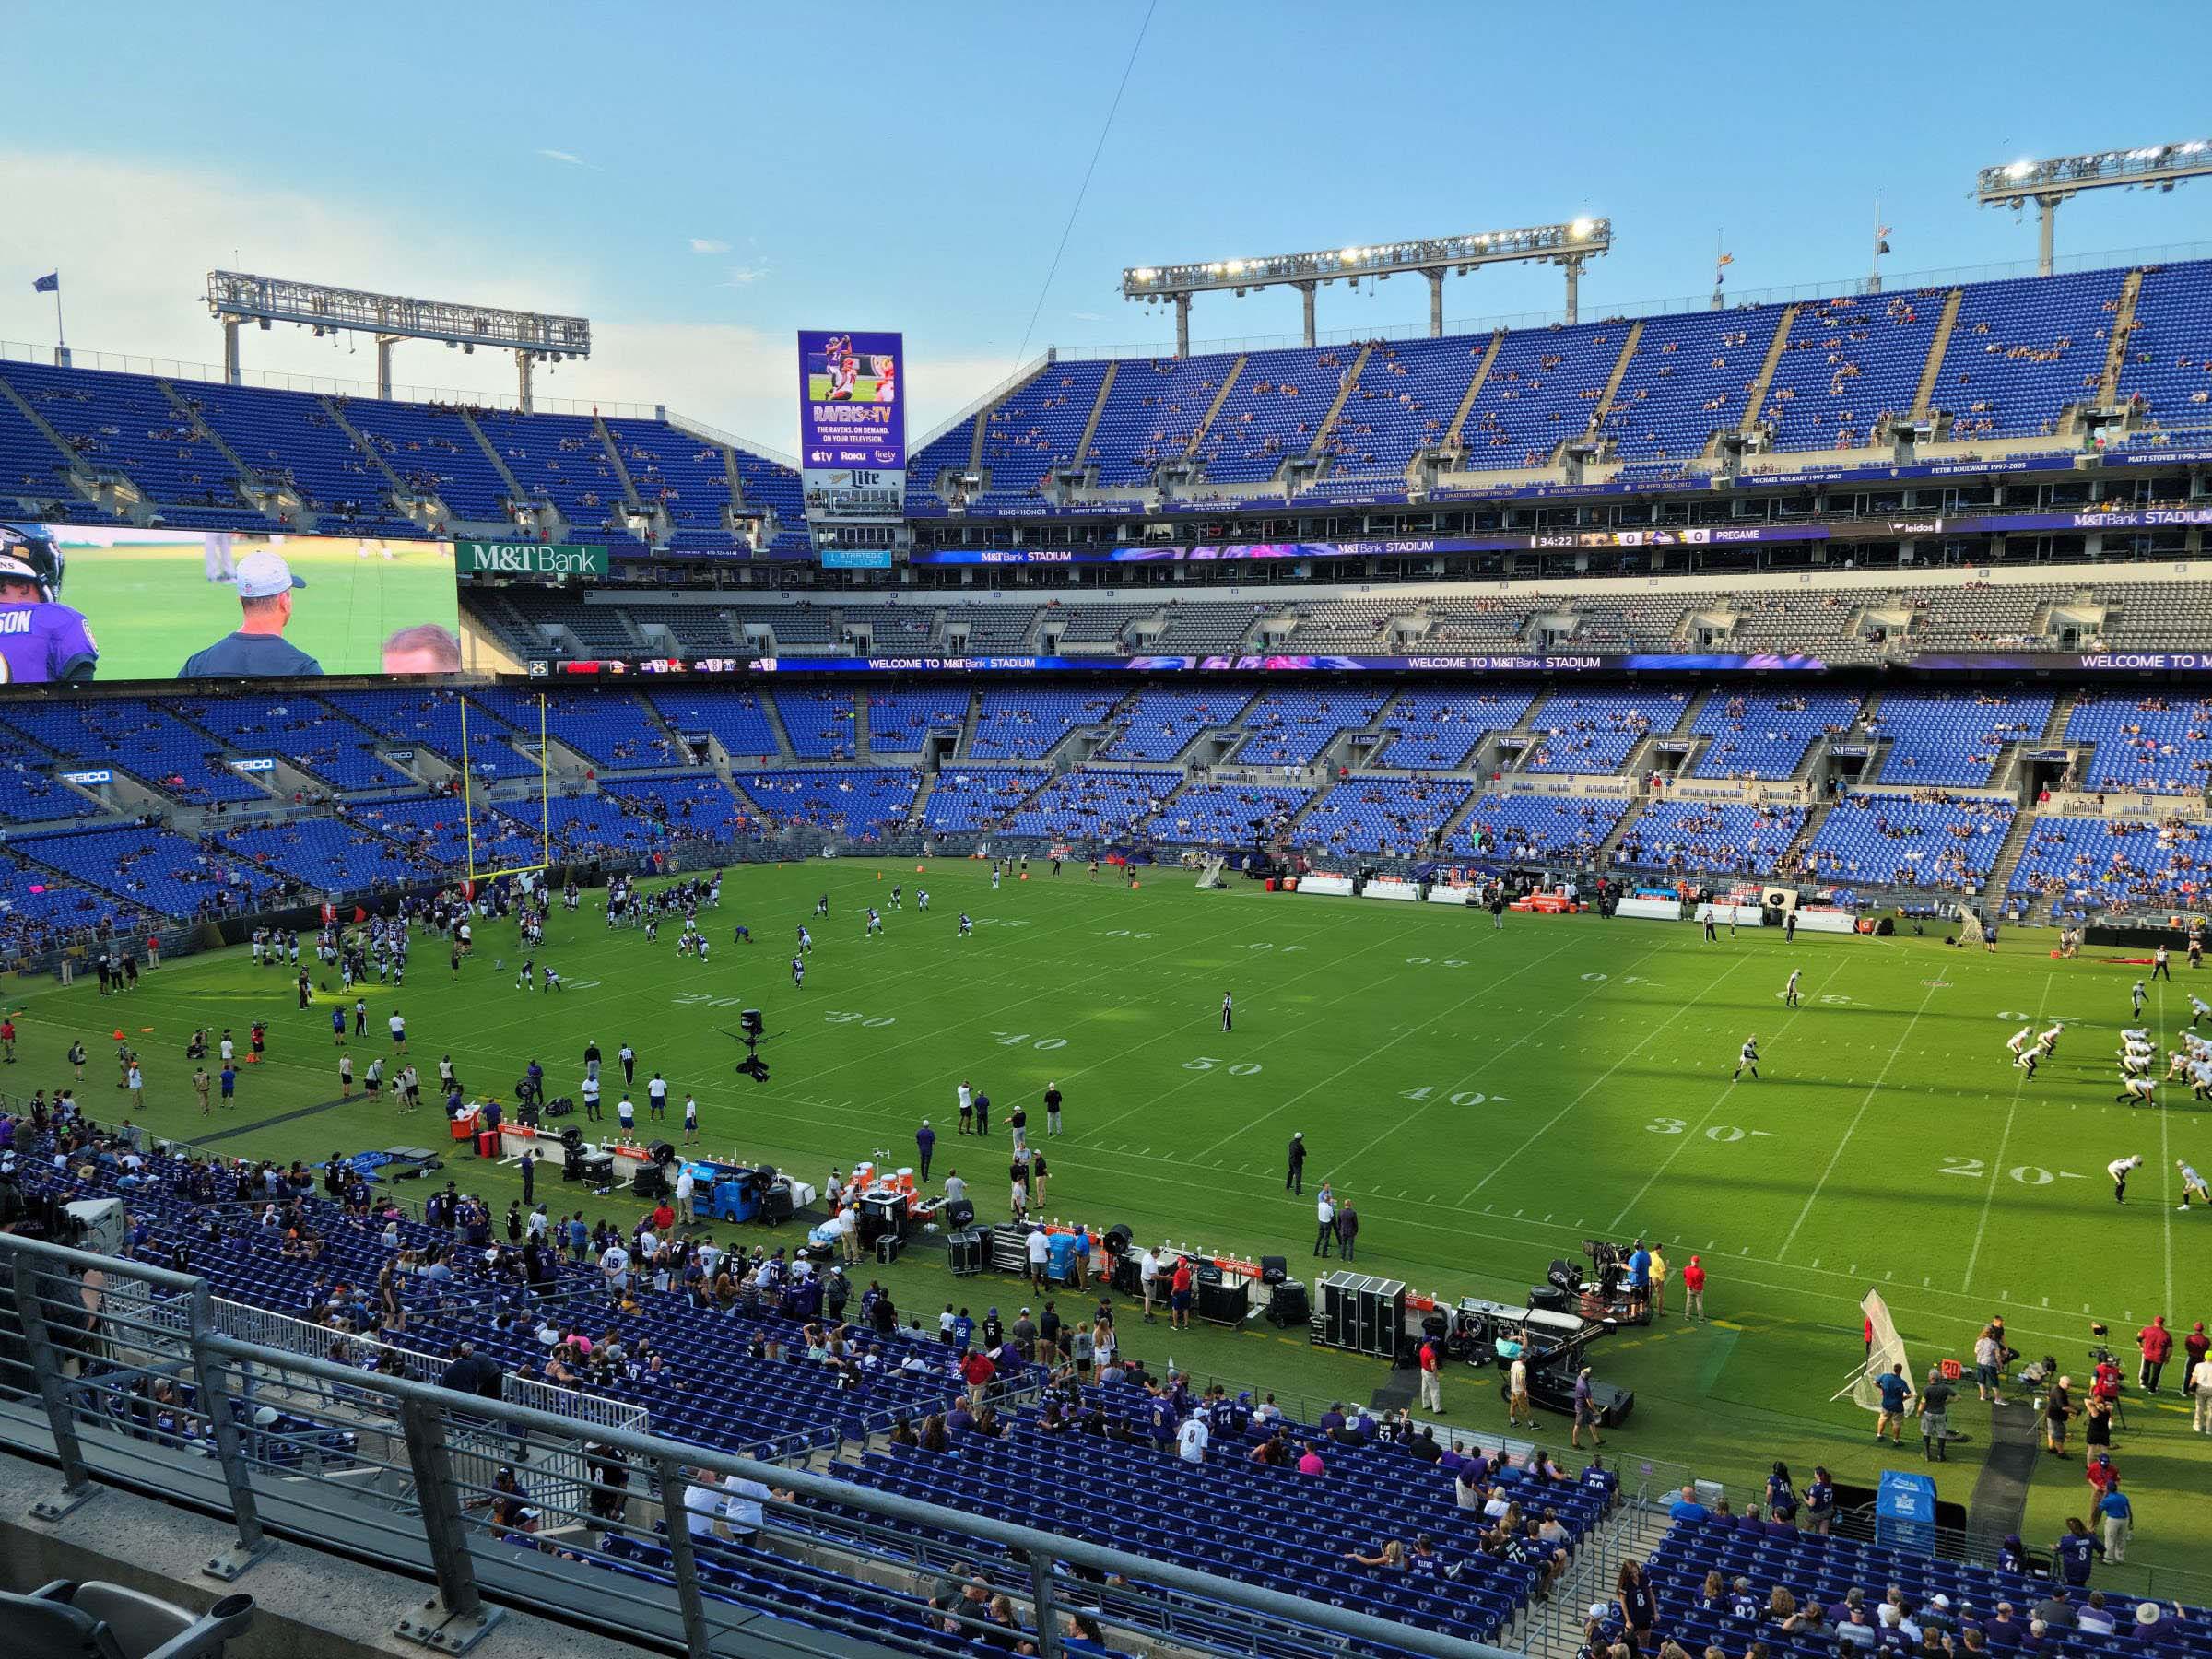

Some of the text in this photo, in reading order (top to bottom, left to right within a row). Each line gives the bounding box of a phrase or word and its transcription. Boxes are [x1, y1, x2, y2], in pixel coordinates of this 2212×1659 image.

[814, 406, 891, 422] RAVENS TV
[821, 452, 832, 461] tv
[1953, 465, 1988, 473] BOULWARE
[1990, 462, 2026, 470] 1997-2005
[851, 469, 879, 488] Lite
[1779, 475, 1807, 483] McCRARY
[1809, 473, 1841, 481] 1997-2002
[2074, 513, 2106, 526] M&T
[2107, 512, 2137, 525] Bank
[1904, 524, 1934, 533] leidos
[1540, 534, 1634, 547] 34:22 0
[1694, 530, 1759, 542] 0 PREGAME
[1338, 541, 1434, 554] M&T Bank STADIUM
[472, 545, 595, 571] M&T Bank
[982, 552, 1071, 561] M&T Bank STADIUM
[869, 659, 1035, 668] WELCOME TO M&T Bank STADIUM
[1408, 656, 1600, 668] WELCOME TO M&T Bank STADIUM
[2081, 655, 2165, 667] WELCOME
[2171, 655, 2194, 667] TO
[532, 663, 546, 674] 25
[1182, 1057, 1262, 1076] 50
[1398, 1086, 1485, 1106] 40
[1646, 1117, 1745, 1141] 30
[173, 1171, 182, 1181] 25
[1937, 1156, 2054, 1184] 20
[201, 1187, 210, 1196] 55
[608, 1257, 619, 1269] 19
[704, 1257, 709, 1266] 8
[718, 1256, 725, 1265] 8
[730, 1263, 738, 1273] 15
[771, 1268, 779, 1280] 44
[307, 1297, 312, 1309] 8
[956, 1327, 966, 1337] 22
[988, 1327, 994, 1335] 15
[1153, 1412, 1161, 1427] 8
[1218, 1412, 1230, 1424] 44
[1188, 1430, 1196, 1443] 8
[1379, 1430, 1391, 1442] 52
[594, 1467, 603, 1484] 8
[1508, 1547, 1527, 1564] 75
[2006, 1560, 2018, 1572] 44
[1637, 1593, 1644, 1607] 8
[1735, 1604, 1757, 1620] 82
